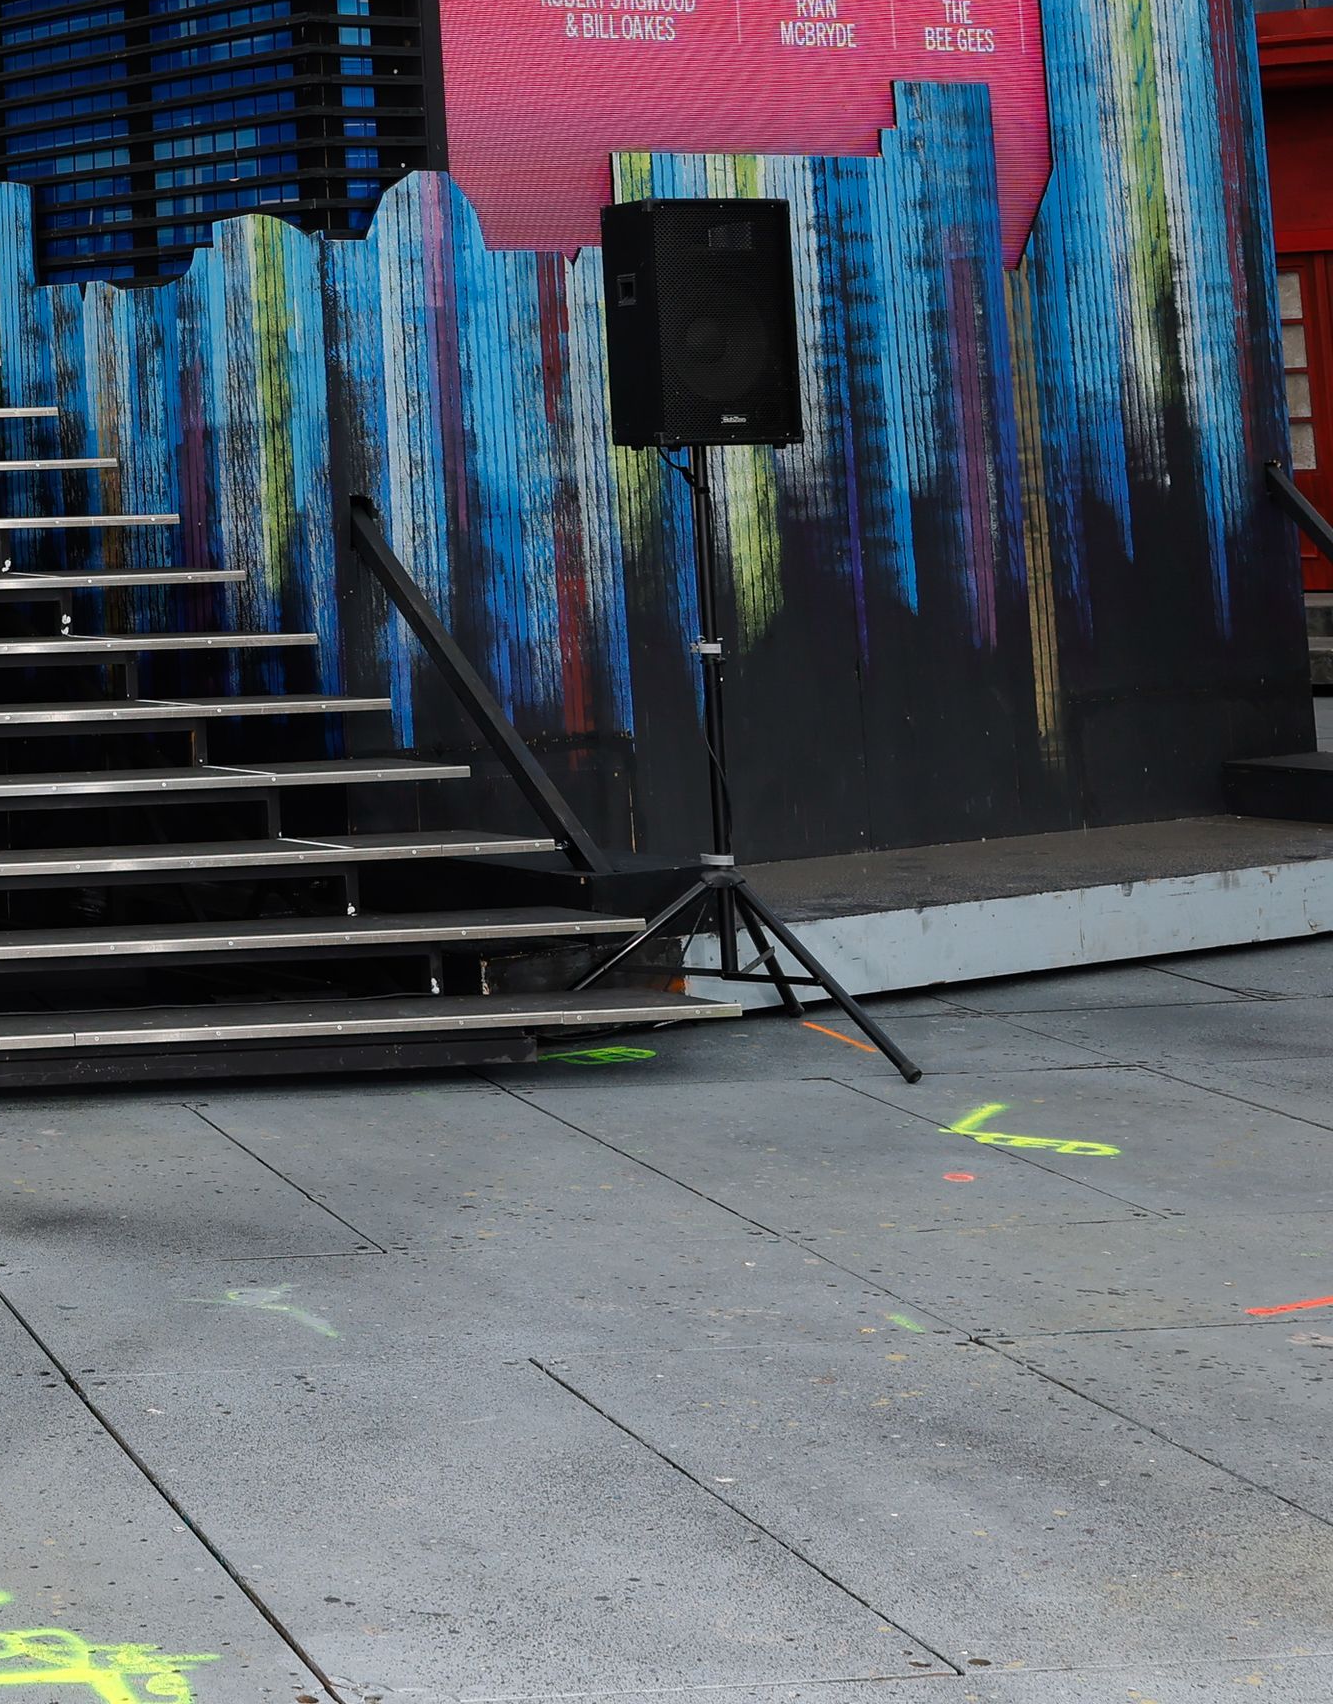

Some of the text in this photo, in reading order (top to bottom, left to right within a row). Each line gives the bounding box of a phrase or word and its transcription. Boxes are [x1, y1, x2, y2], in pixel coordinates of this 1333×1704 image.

[942, 0, 974, 25] THE
[565, 13, 676, 41] & BILL OAKES
[780, 21, 857, 48] MCBRYDE
[924, 27, 995, 52] BEE GEES
